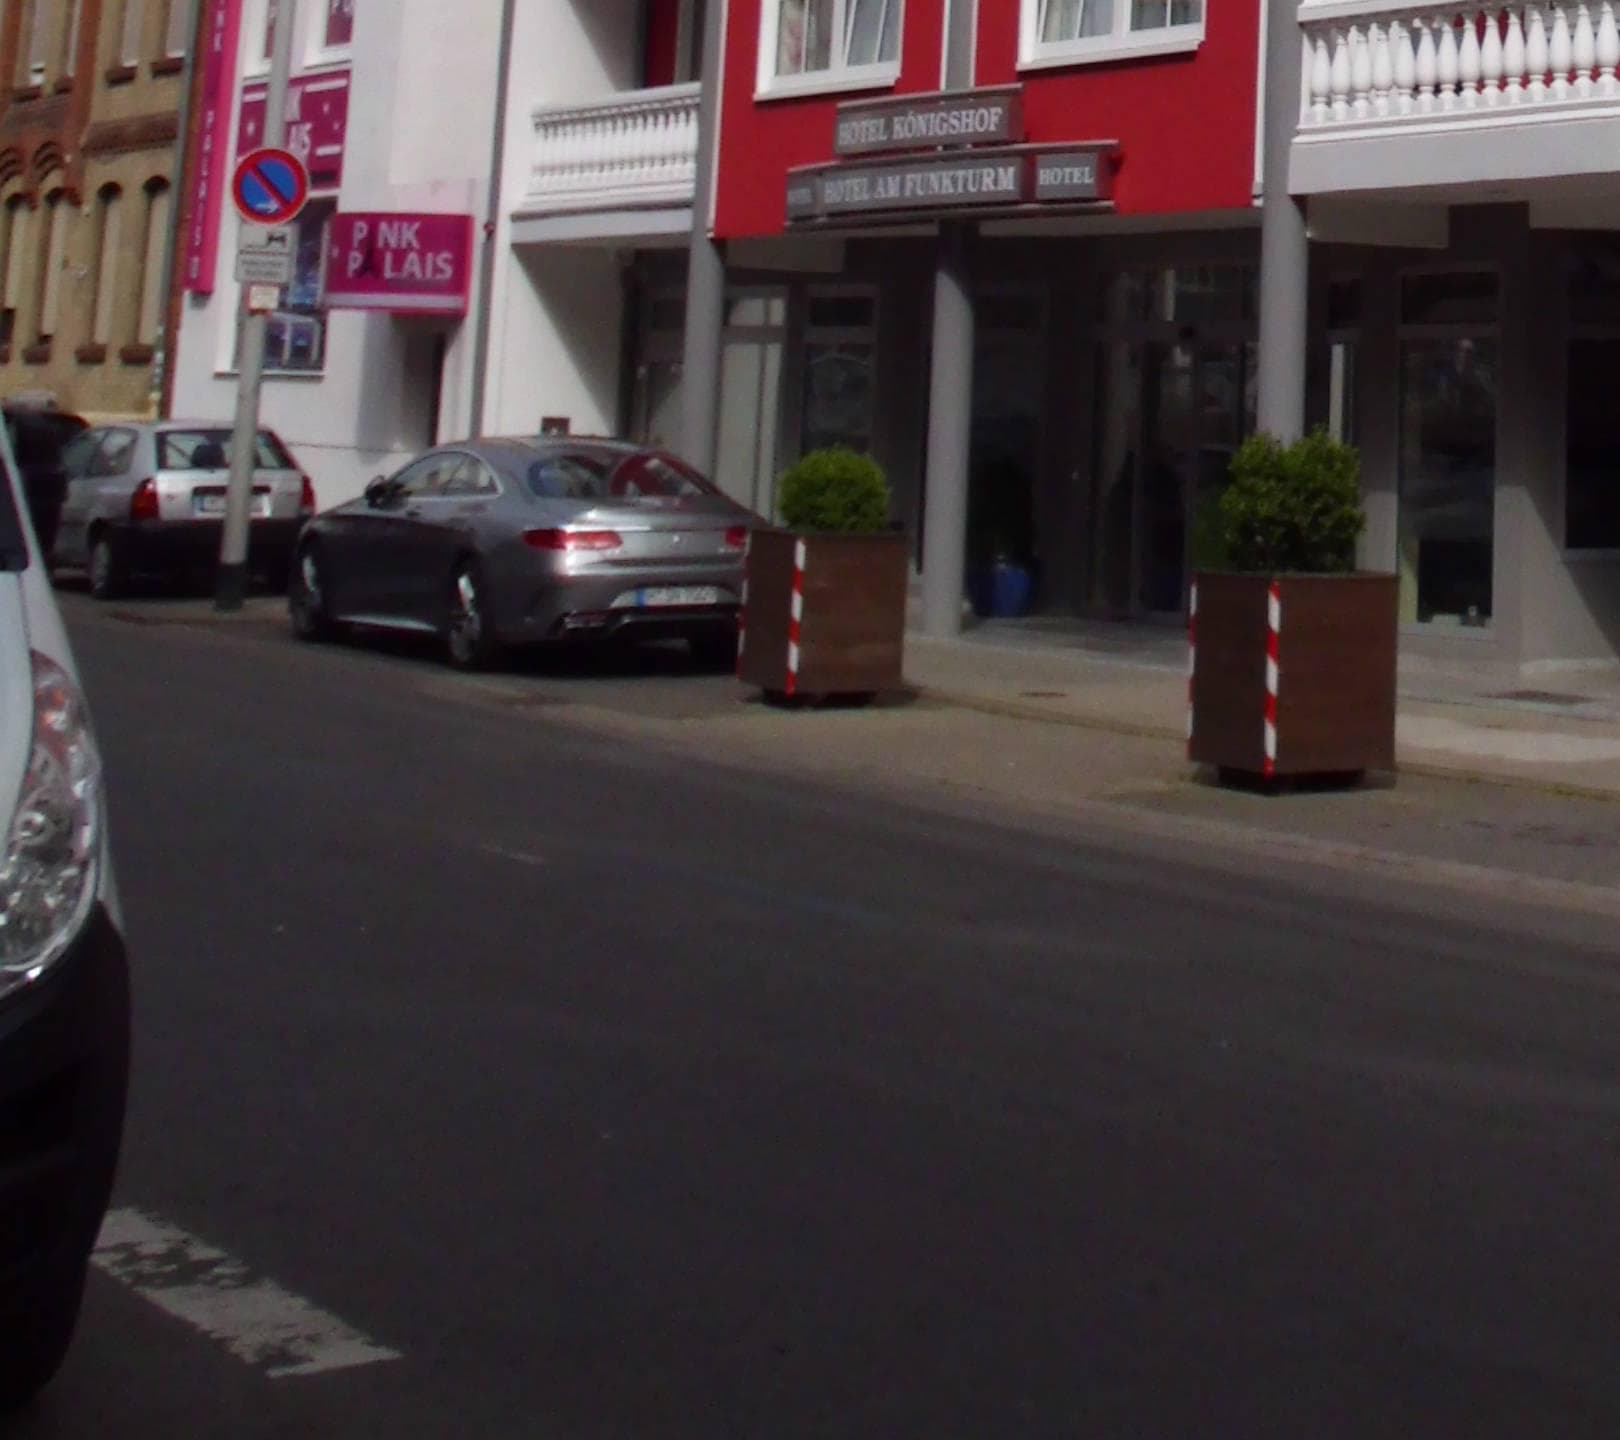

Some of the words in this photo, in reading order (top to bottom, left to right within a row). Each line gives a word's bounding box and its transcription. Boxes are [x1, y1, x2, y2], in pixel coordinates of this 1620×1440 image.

[838, 117, 887, 145] HOTEL
[893, 106, 1003, 140] KÖNIGSHOF
[824, 176, 869, 203] HOTEL
[873, 175, 901, 199] AM
[904, 165, 1016, 197] FUNKTURM
[1039, 166, 1095, 185] HOTEL
